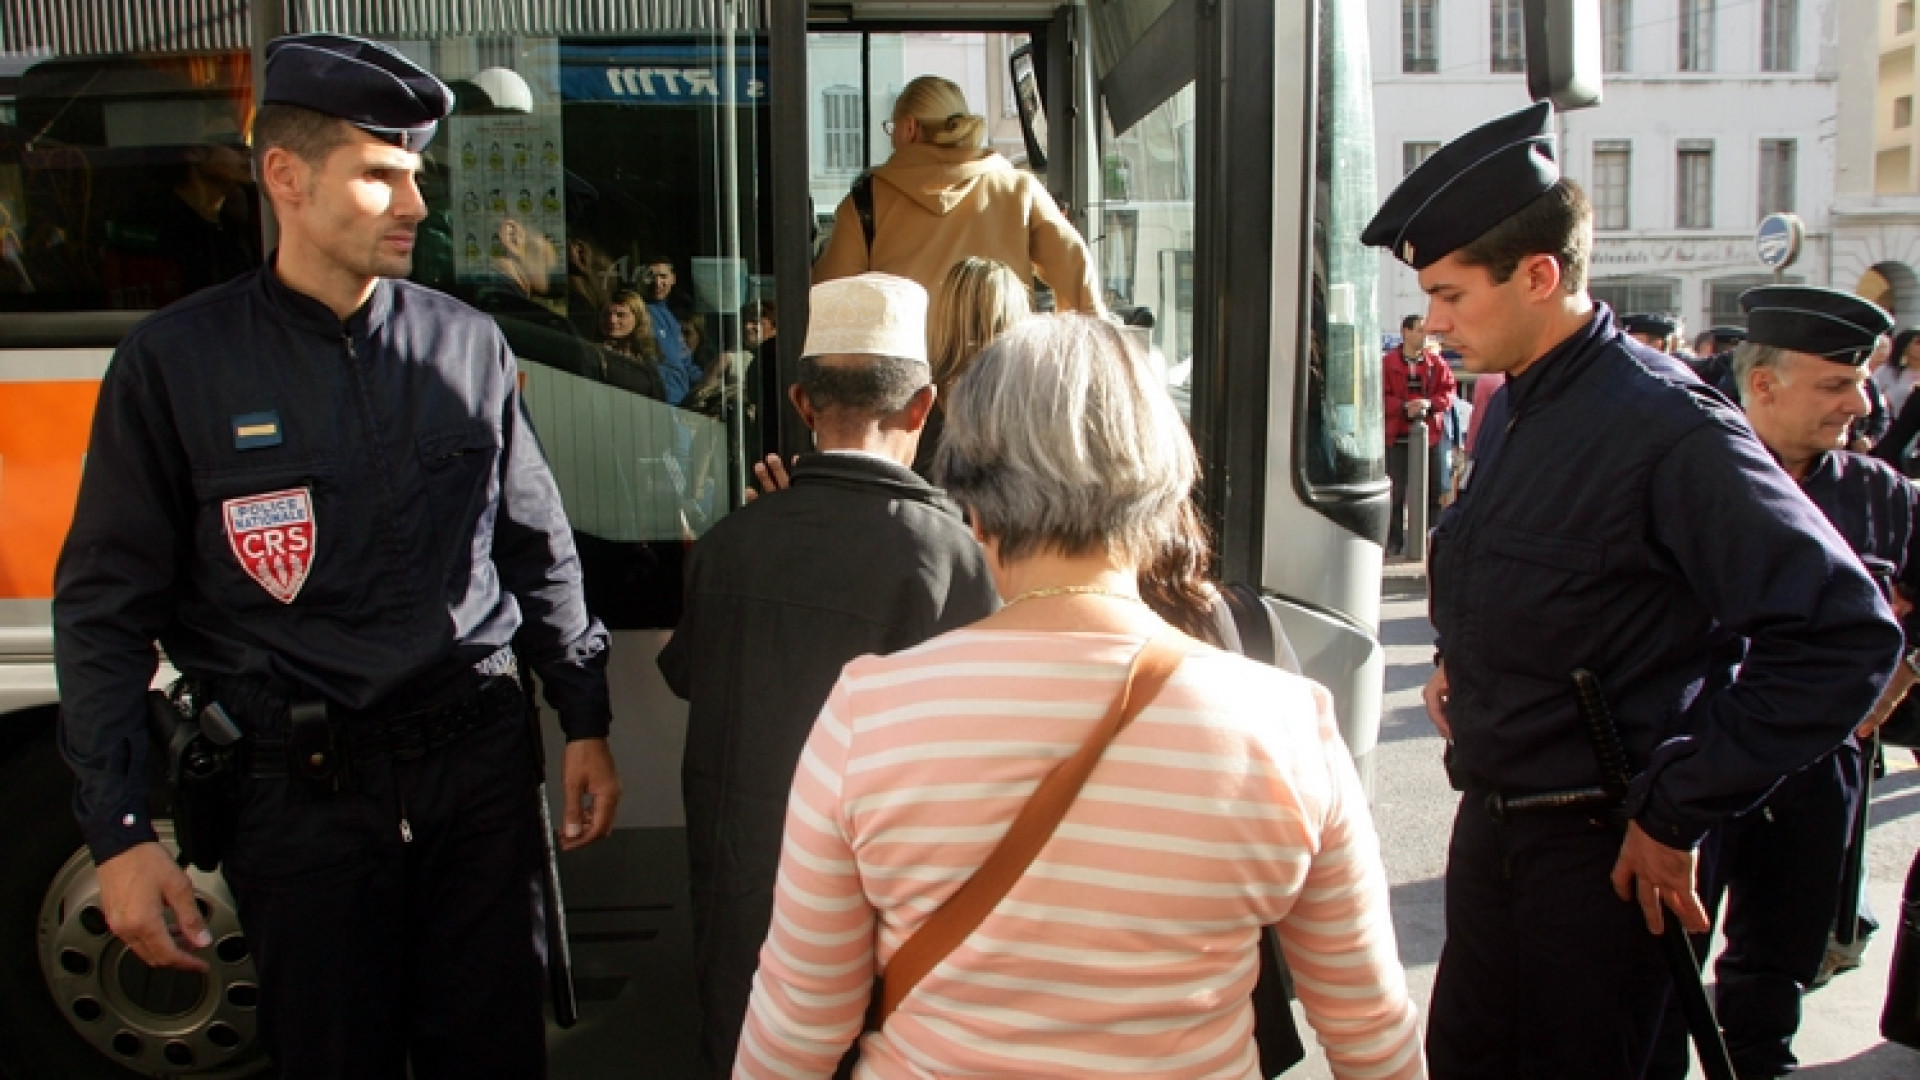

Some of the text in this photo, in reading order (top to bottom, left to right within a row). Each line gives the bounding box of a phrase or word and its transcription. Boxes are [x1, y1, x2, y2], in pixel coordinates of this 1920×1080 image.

[237, 498, 298, 517] POLICE
[234, 508, 304, 528] NATIONALE
[242, 526, 308, 559] CRS
